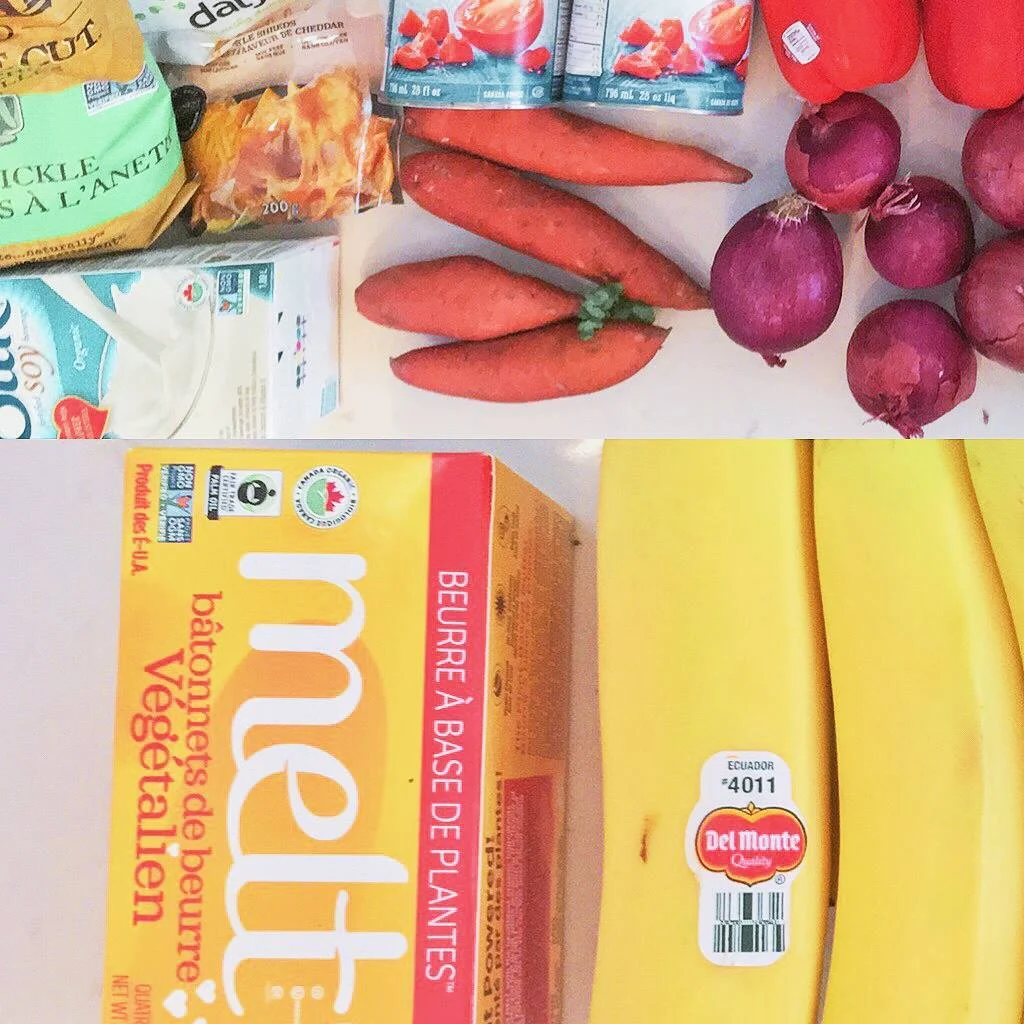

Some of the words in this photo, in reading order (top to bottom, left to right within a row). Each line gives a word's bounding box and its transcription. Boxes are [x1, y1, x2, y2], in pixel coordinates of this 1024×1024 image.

[21, 19, 103, 67] CUT
[23, 189, 49, 217] À
[262, 201, 289, 216] 200
[134, 463, 153, 510] Produit
[132, 512, 149, 534] des
[435, 570, 469, 683] BEURRE
[181, 590, 224, 785] bâtonnets
[434, 690, 473, 711] À
[431, 719, 464, 794] BASE
[728, 760, 774, 771] ECUADOR
[130, 648, 186, 927] Végétalien
[223, 551, 409, 1016] melt
[180, 787, 215, 840] de
[429, 803, 461, 841] DE
[705, 830, 736, 851] Del
[739, 830, 800, 851] Monte
[731, 853, 773, 868] Quality
[175, 844, 213, 984] beurre
[425, 848, 460, 982] PLANTES
[112, 974, 129, 998] NET
[111, 1001, 129, 1022] WT
